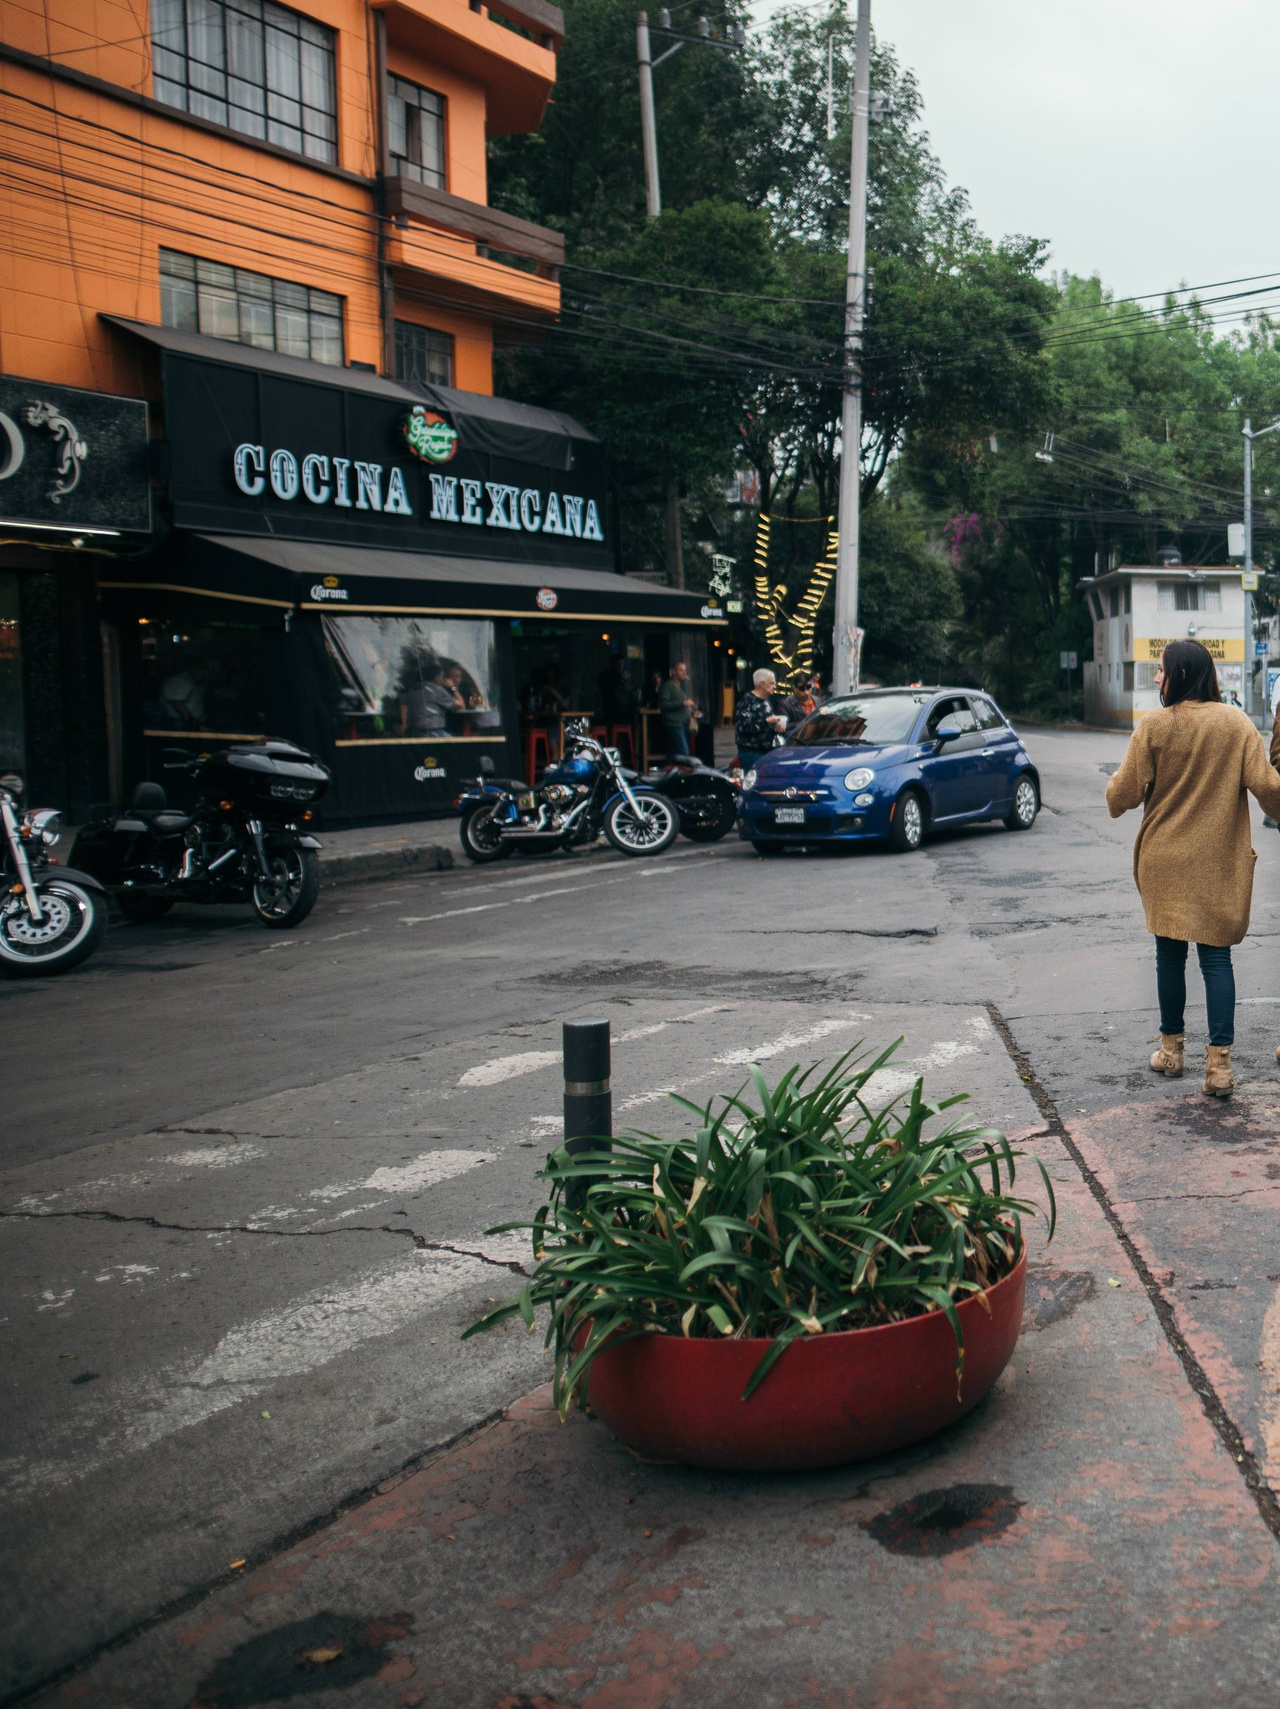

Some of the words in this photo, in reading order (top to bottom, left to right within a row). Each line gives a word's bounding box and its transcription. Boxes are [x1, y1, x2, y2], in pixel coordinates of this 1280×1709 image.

[233, 442, 413, 516] COCINA
[428, 473, 604, 541] MEXICANA
[310, 584, 348, 601] Corona
[701, 605, 723, 618] Corona
[414, 766, 446, 782] Corona
